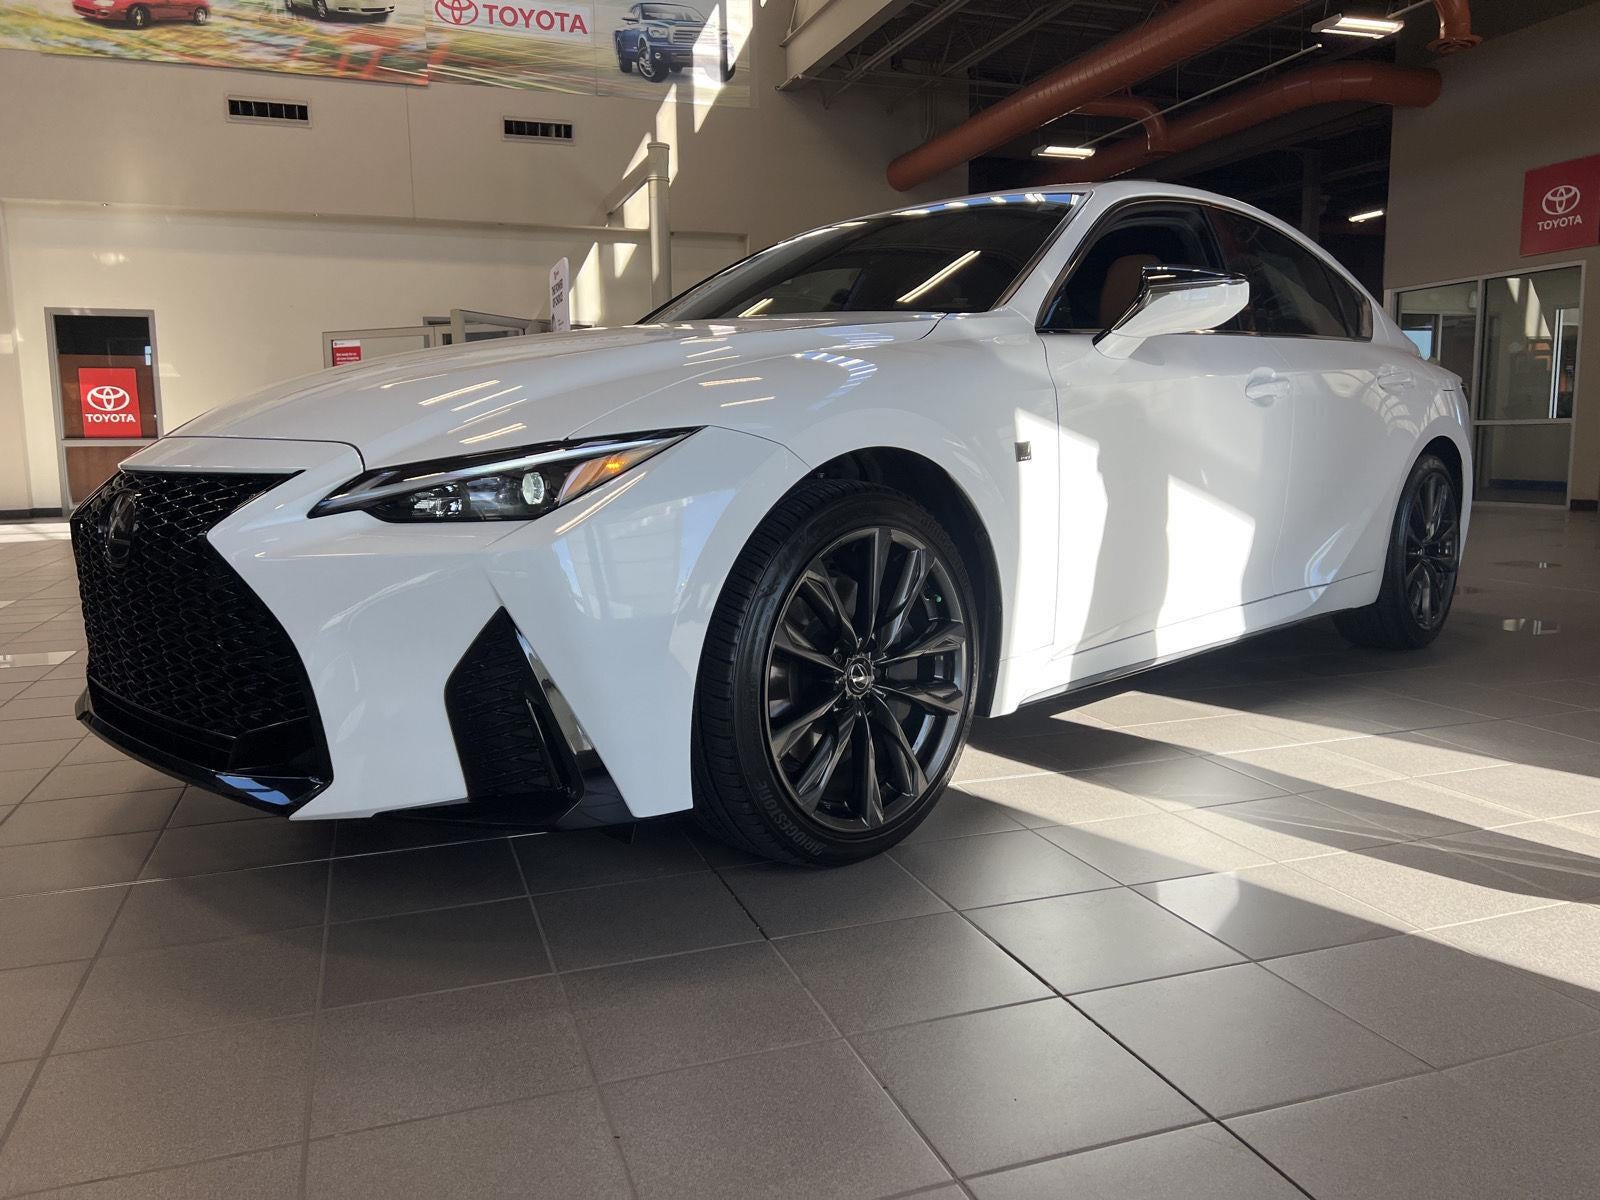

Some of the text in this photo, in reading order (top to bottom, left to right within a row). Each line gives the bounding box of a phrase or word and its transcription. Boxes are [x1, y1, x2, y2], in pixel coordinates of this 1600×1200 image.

[482, 4, 588, 34] TOYOTA
[1537, 214, 1583, 231] TOYOTA
[85, 413, 136, 423] TOYOTA
[753, 779, 827, 857] BRIDGESTONE
